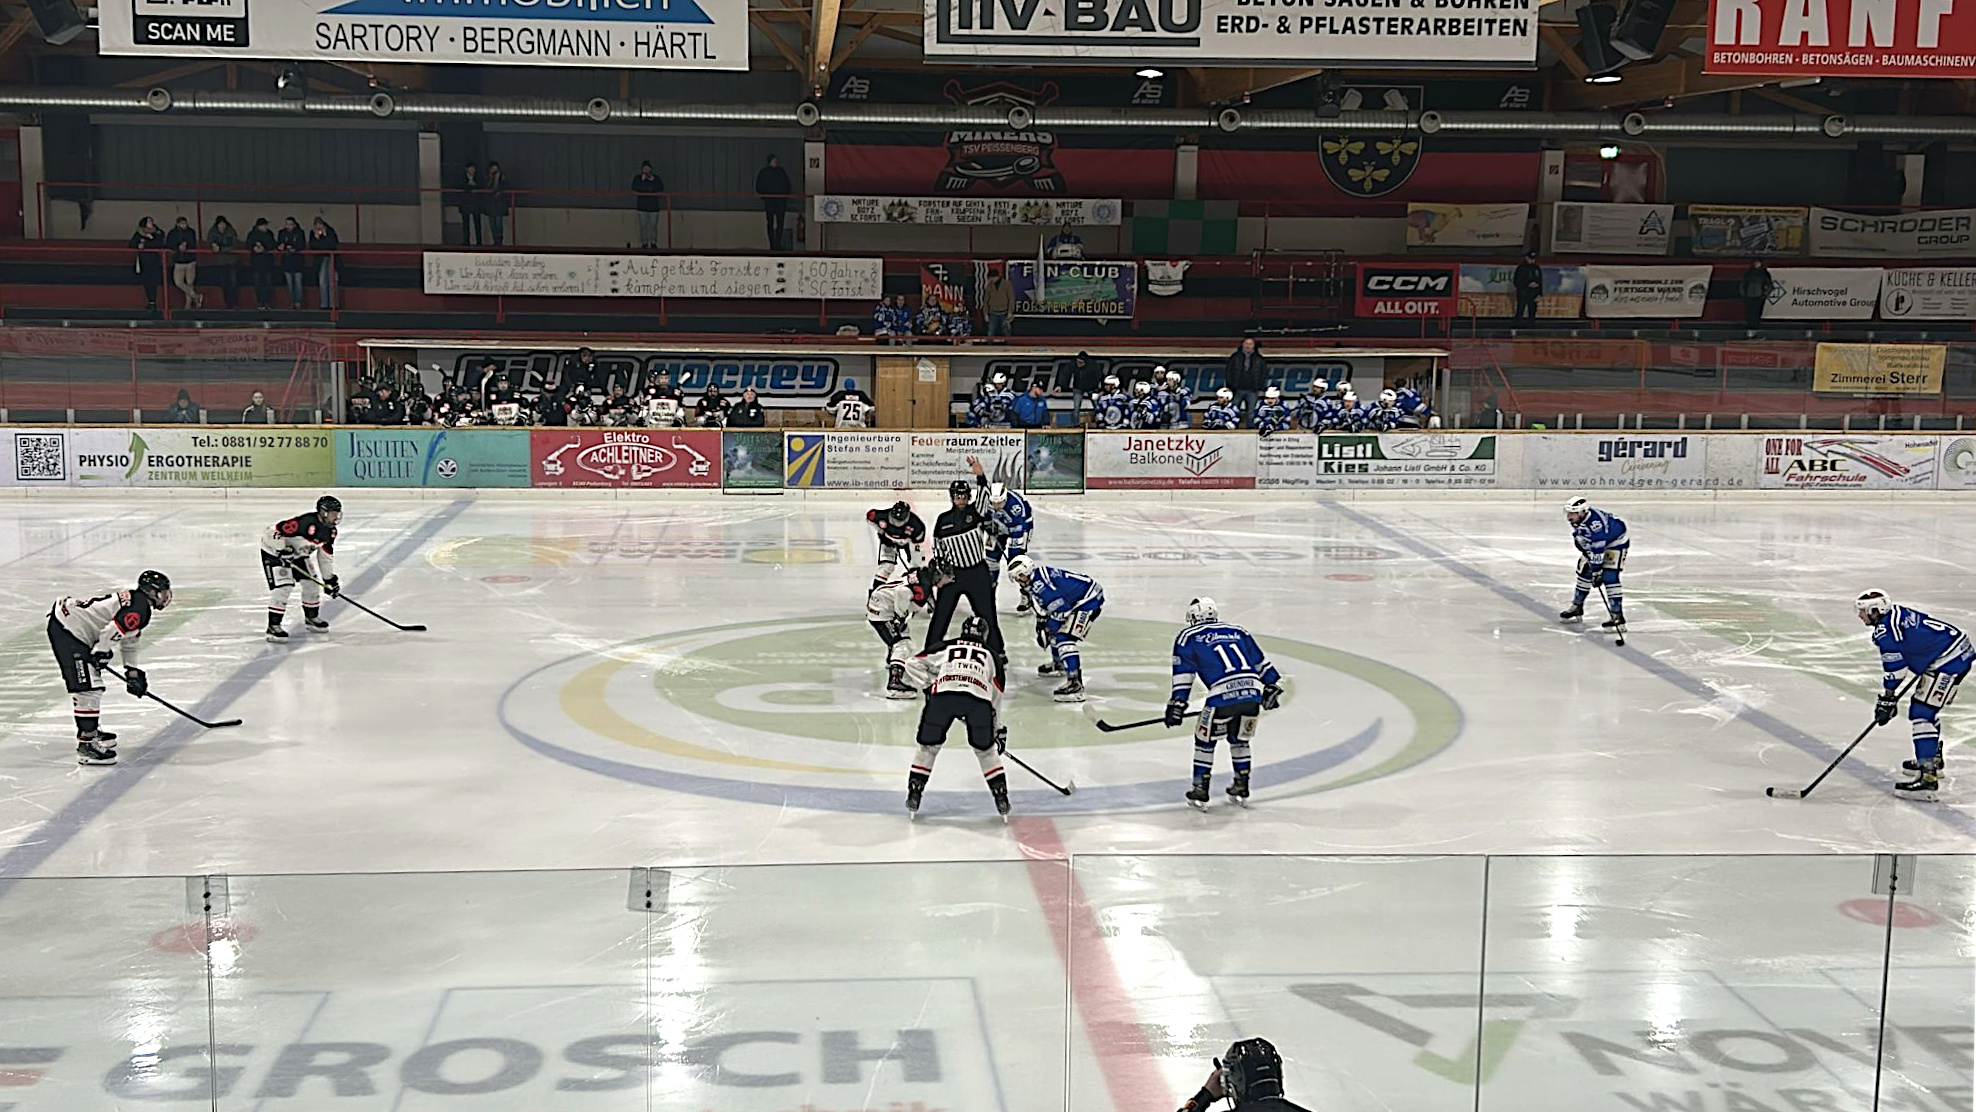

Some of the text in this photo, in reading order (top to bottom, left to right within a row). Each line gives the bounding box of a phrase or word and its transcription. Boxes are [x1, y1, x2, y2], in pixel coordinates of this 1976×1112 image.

[148, 22, 235, 42] SCAN ME
[1216, 15, 1528, 37] ERD- & PFLASTERARBEITEN
[316, 22, 716, 60] SARTORY BERGMANN HÄRTL
[1713, 52, 1793, 65] BETONBOHREN
[1802, 52, 1873, 66] BETONSÄGEN
[963, 143, 1040, 156] TSV PEISSENBERG
[1917, 235, 1970, 245] GROUP
[623, 259, 659, 277] Auf
[709, 260, 770, 278] Forster
[810, 261, 866, 280] 60 Jahre
[625, 279, 772, 298] kämpfen und siegen
[810, 280, 864, 297] SC Forst
[1367, 275, 1449, 292] CCM
[922, 284, 963, 301] MANN
[1793, 287, 1848, 300] Hirschvogel
[1071, 302, 1125, 314] FREUNDE
[1373, 301, 1440, 315] ALL OUT.
[1791, 298, 1847, 307] Automotive
[1830, 371, 1928, 385] Zimmerei Sterr
[843, 402, 860, 421] 25
[192, 436, 219, 448] Tel.:
[349, 432, 419, 458] JESUITEN
[603, 432, 650, 444] Elektro
[827, 434, 902, 443] Ingenieurbüro
[911, 436, 1021, 447] Feuerraum Zeitler
[1123, 435, 1206, 455] Janetzky
[827, 444, 895, 453] Stefan Sendl
[946, 447, 997, 455] Meisterbetrieb
[1321, 443, 1373, 458] Listl
[1598, 437, 1688, 462] gérard
[1765, 438, 1802, 456] ONE FOR
[79, 455, 252, 468] PHYSIO ERGOTHERAPIE
[590, 446, 664, 465] ACHLEITNER
[1130, 453, 1184, 465] Balkone
[354, 460, 414, 480] QUELLE
[1323, 462, 1370, 474] Kies
[1372, 463, 1486, 472] Johann Listl GmbH & Co. KG
[1764, 457, 1780, 474] ALL
[1782, 459, 1850, 477] ABC
[148, 471, 253, 481] ZENTRUM WEILHEIM
[1785, 473, 1867, 482] Fahrschule
[826, 480, 904, 488] www.ib-sendl.de
[1213, 642, 1252, 673] 11
[104, 1027, 940, 1101] GROSCH
